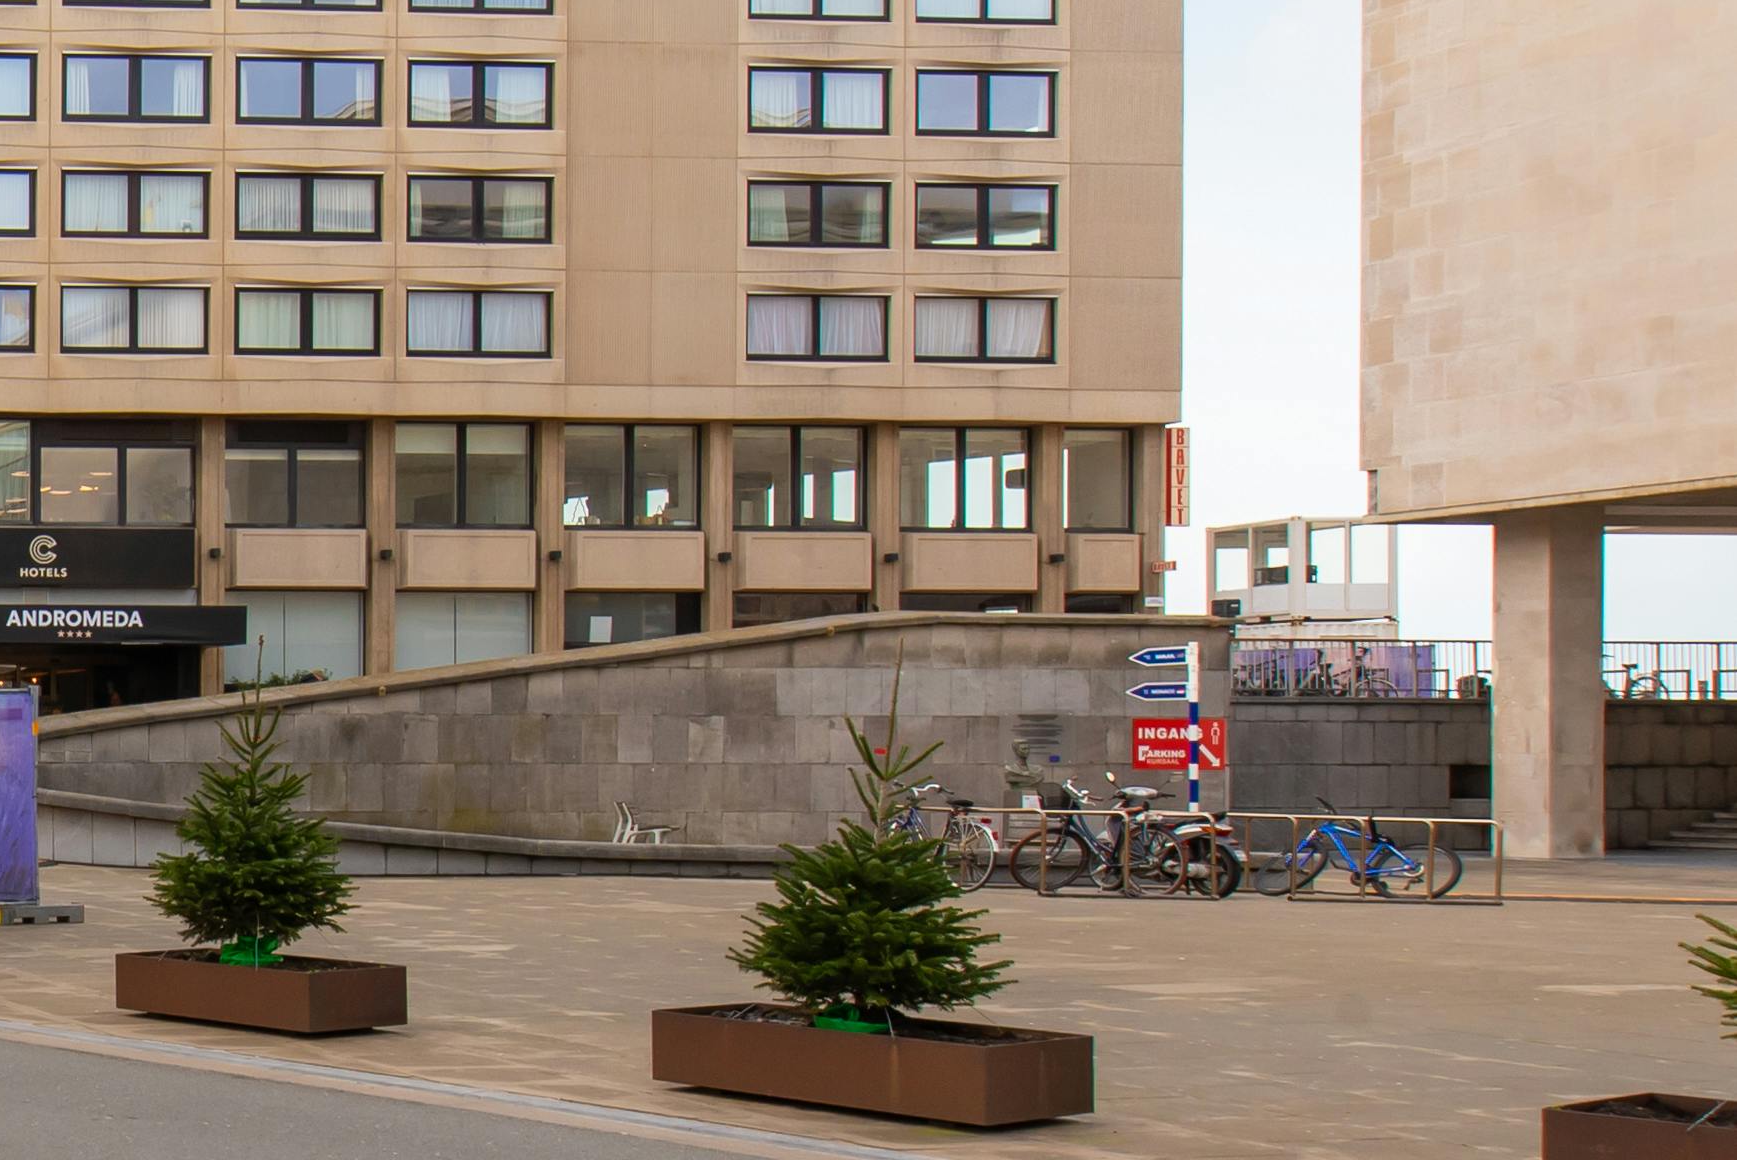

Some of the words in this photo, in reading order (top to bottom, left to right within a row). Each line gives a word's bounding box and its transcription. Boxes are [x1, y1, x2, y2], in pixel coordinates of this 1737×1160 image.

[1176, 428, 1185, 525] BAVET
[19, 567, 68, 578] HOTELS
[6, 609, 143, 628] ANDROMEDA
